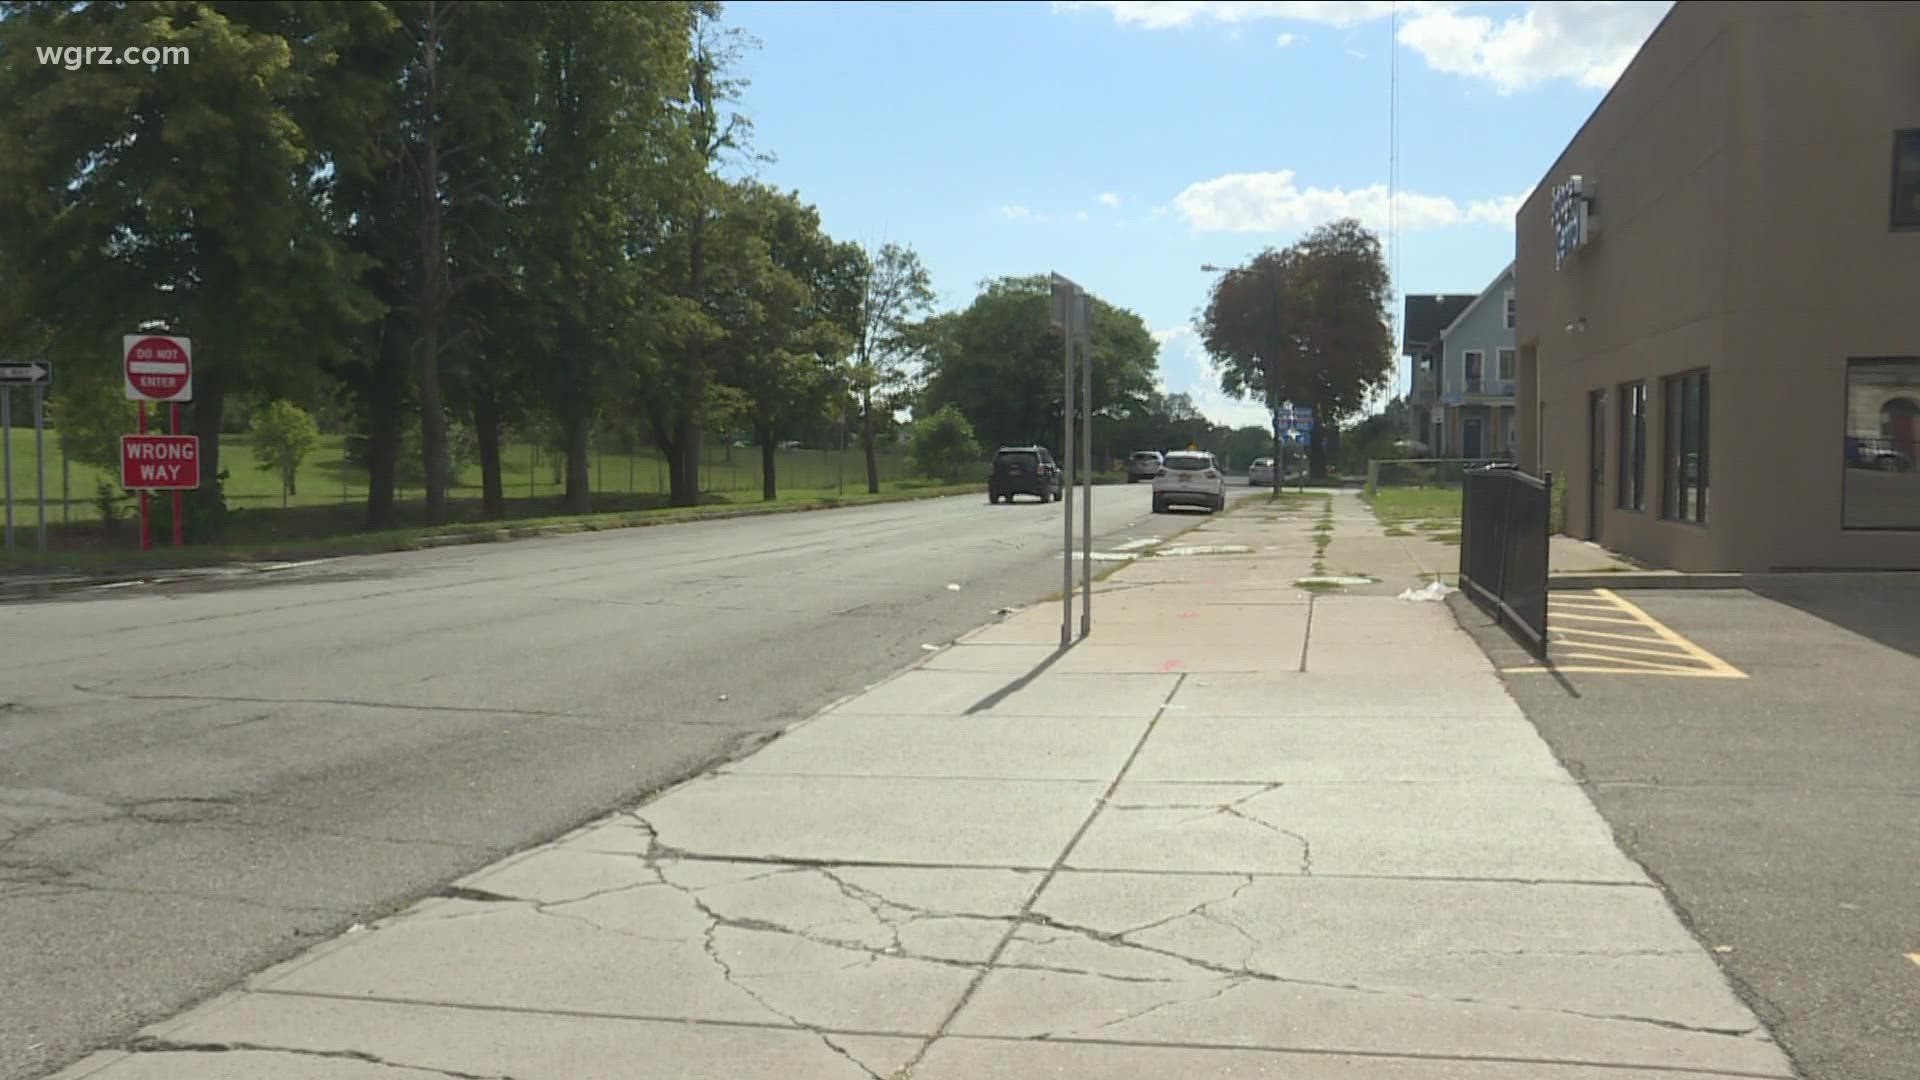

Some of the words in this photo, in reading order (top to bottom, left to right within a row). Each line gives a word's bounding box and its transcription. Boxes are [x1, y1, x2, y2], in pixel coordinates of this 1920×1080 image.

[136, 348, 152, 360] DO
[157, 349, 179, 360] NOT
[141, 377, 176, 388] ENTER
[126, 443, 194, 460] WRONG
[140, 464, 181, 481] WAY
